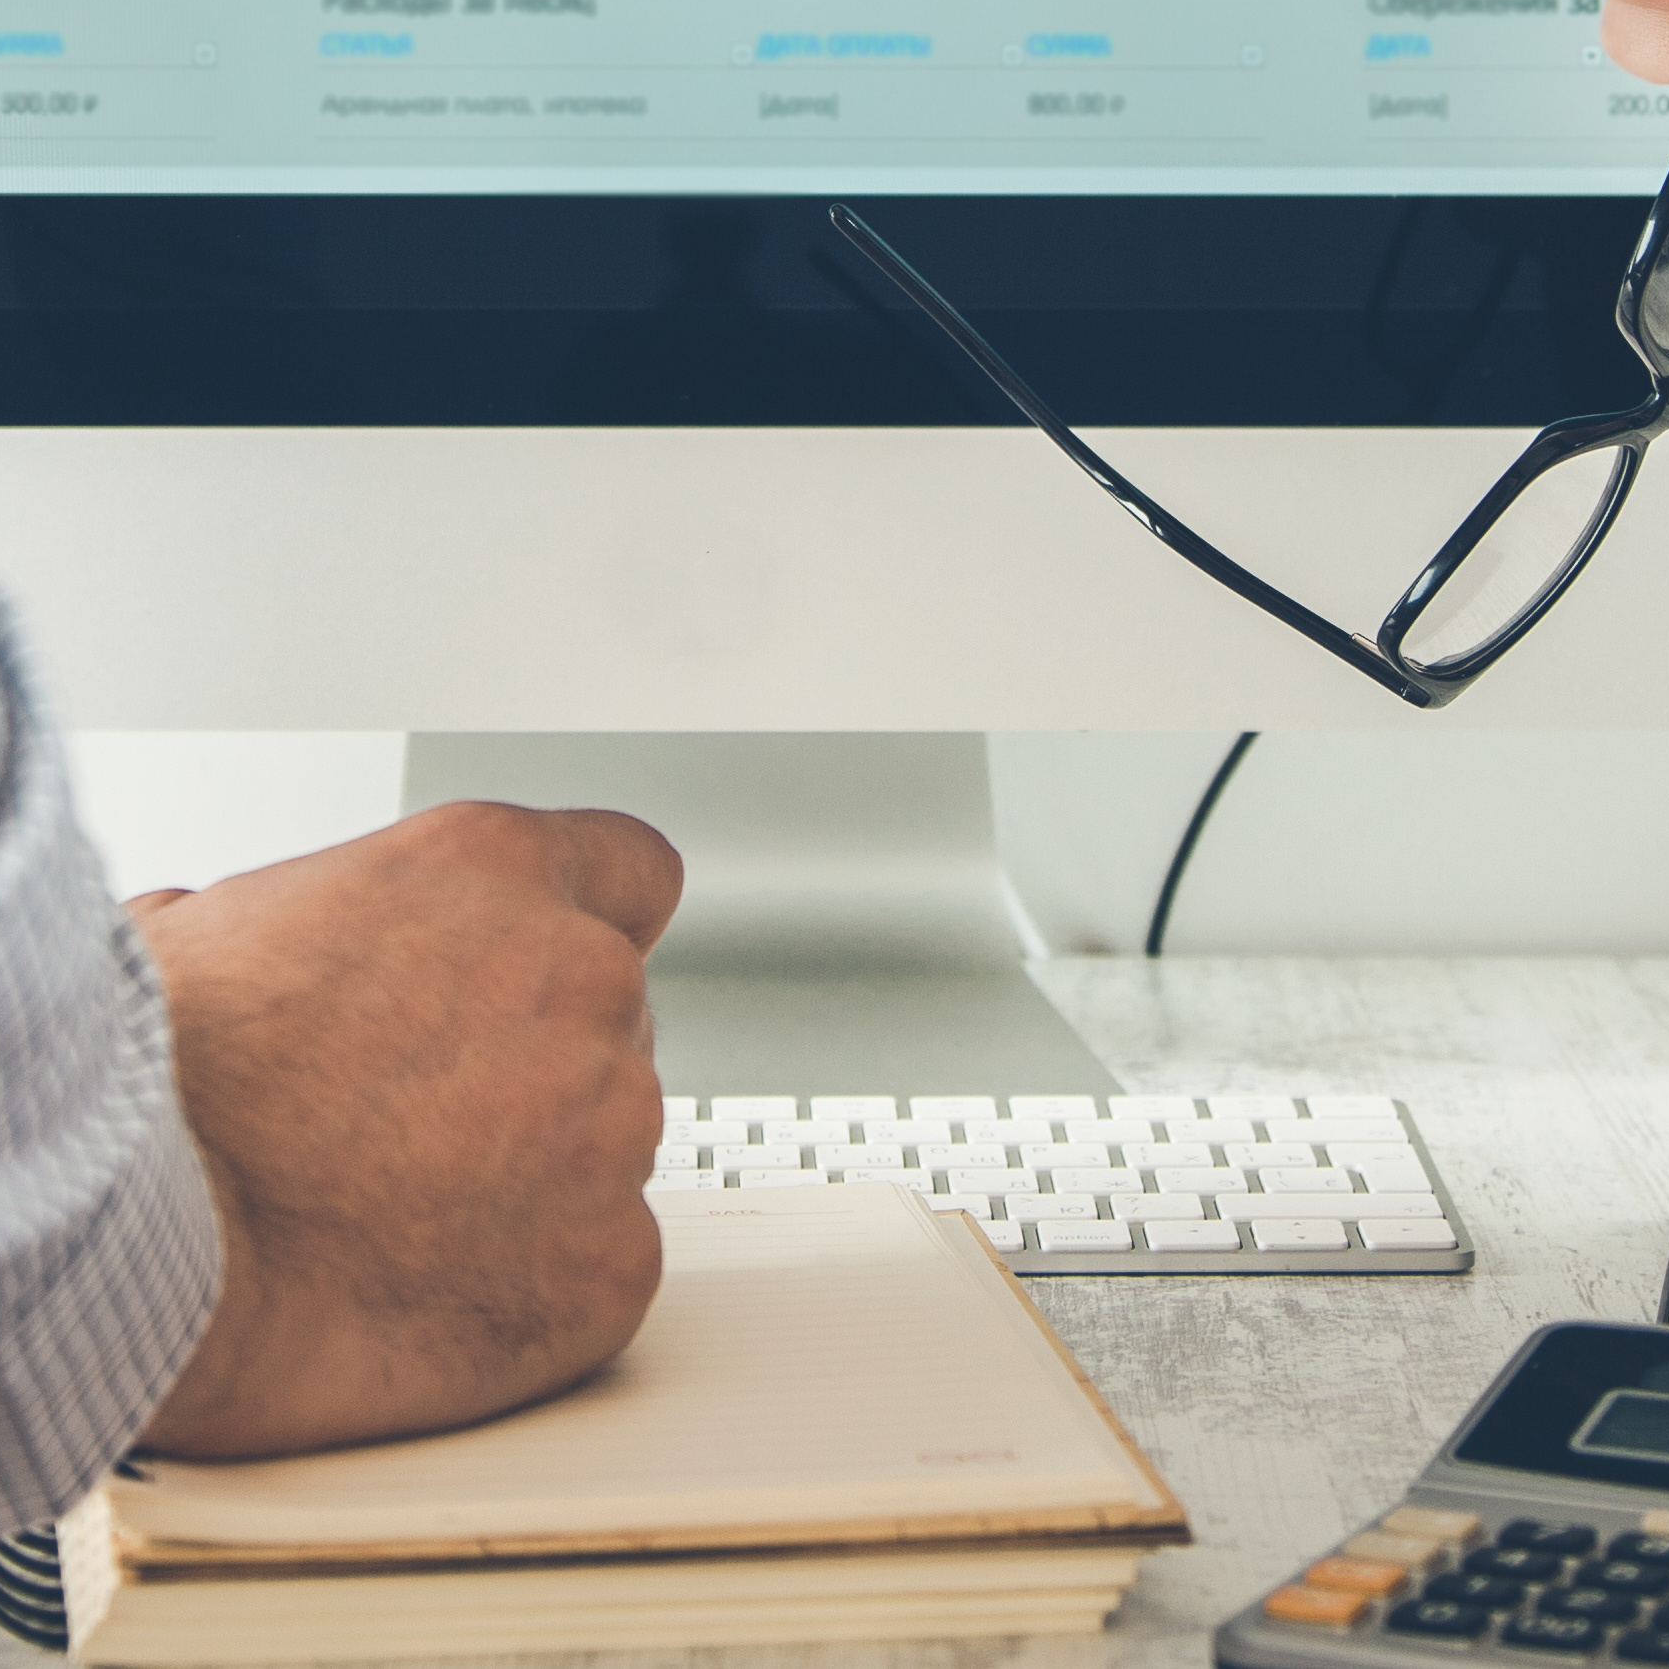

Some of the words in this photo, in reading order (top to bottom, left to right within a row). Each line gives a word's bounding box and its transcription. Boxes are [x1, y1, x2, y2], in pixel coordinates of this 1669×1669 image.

[319, 31, 415, 59] СТАТЬЯ
[756, 32, 822, 60] ДАТА
[826, 32, 932, 59] ОПЛАТЫ
[1025, 32, 1113, 59] СУММА
[1364, 32, 1433, 62] ДАТА
[320, 93, 450, 118] Арендная
[542, 95, 648, 117] ипотека
[708, 1209, 763, 1217] DATE
